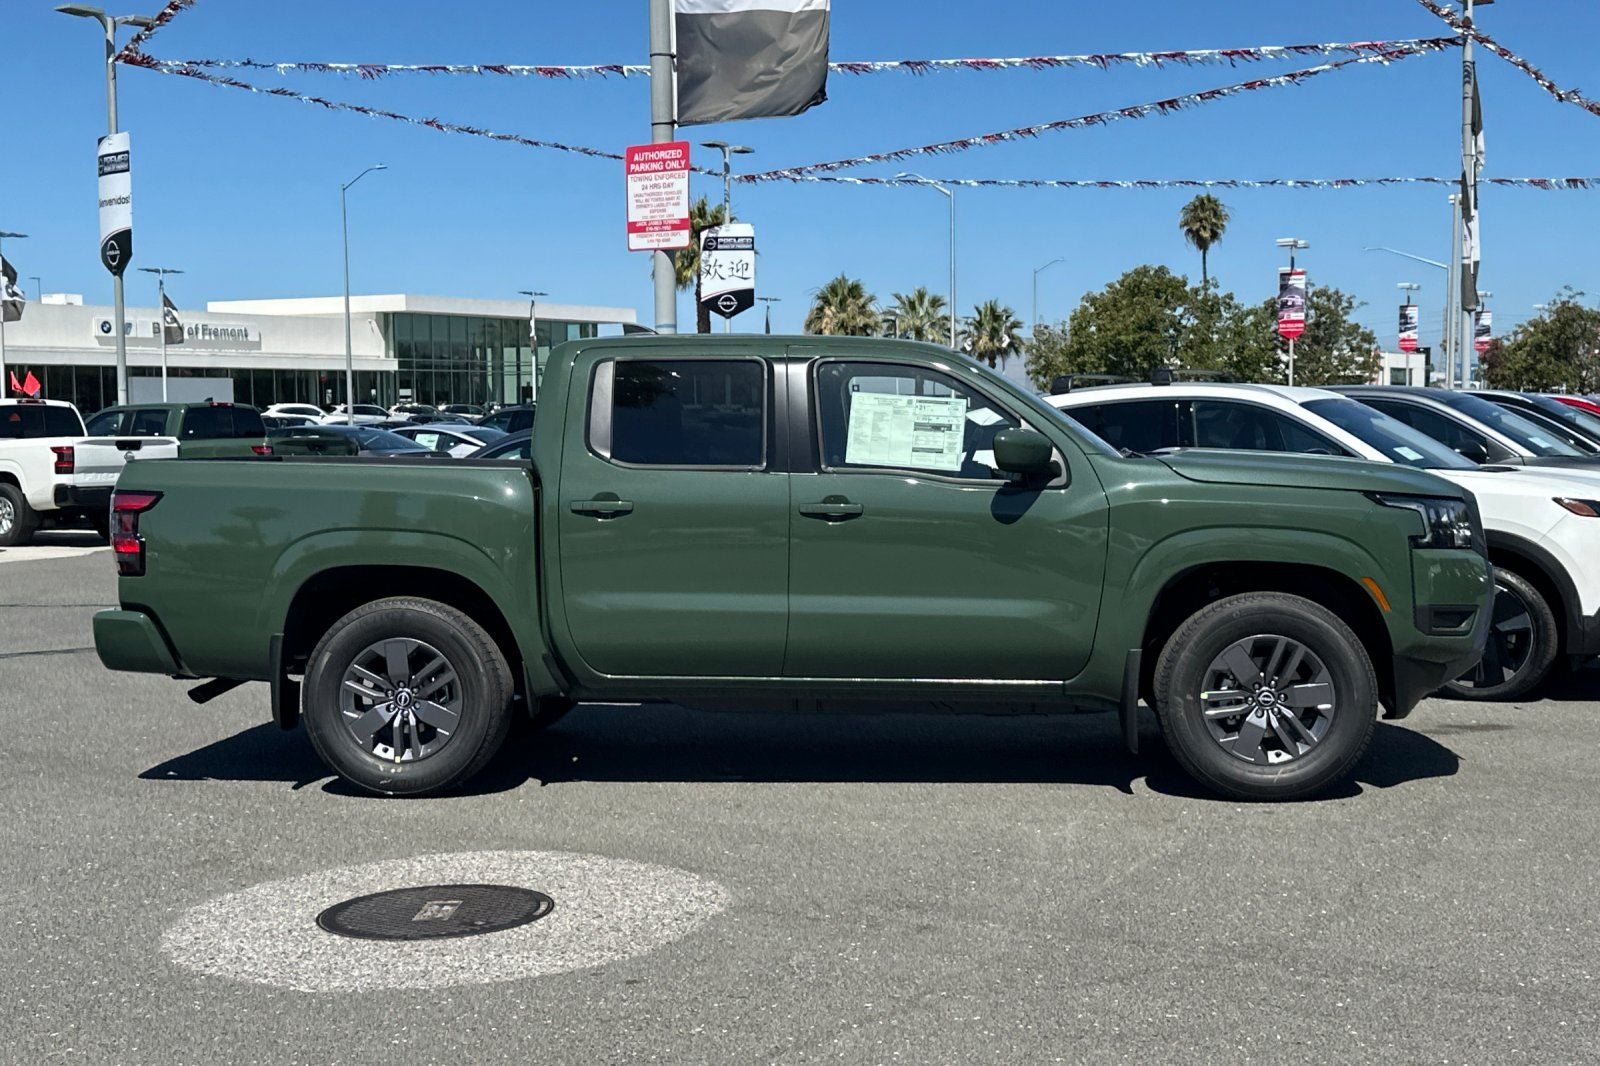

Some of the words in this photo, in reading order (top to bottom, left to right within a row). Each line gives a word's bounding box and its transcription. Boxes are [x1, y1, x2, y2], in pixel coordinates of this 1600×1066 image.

[634, 150, 683, 162] AUTHORIZED
[631, 162, 664, 172] PARKING
[666, 160, 686, 170] ONLY
[655, 173, 686, 181] ENFORCED
[704, 259, 753, 280] 欢迎
[188, 324, 199, 336] of
[202, 324, 249, 339] Fremont
